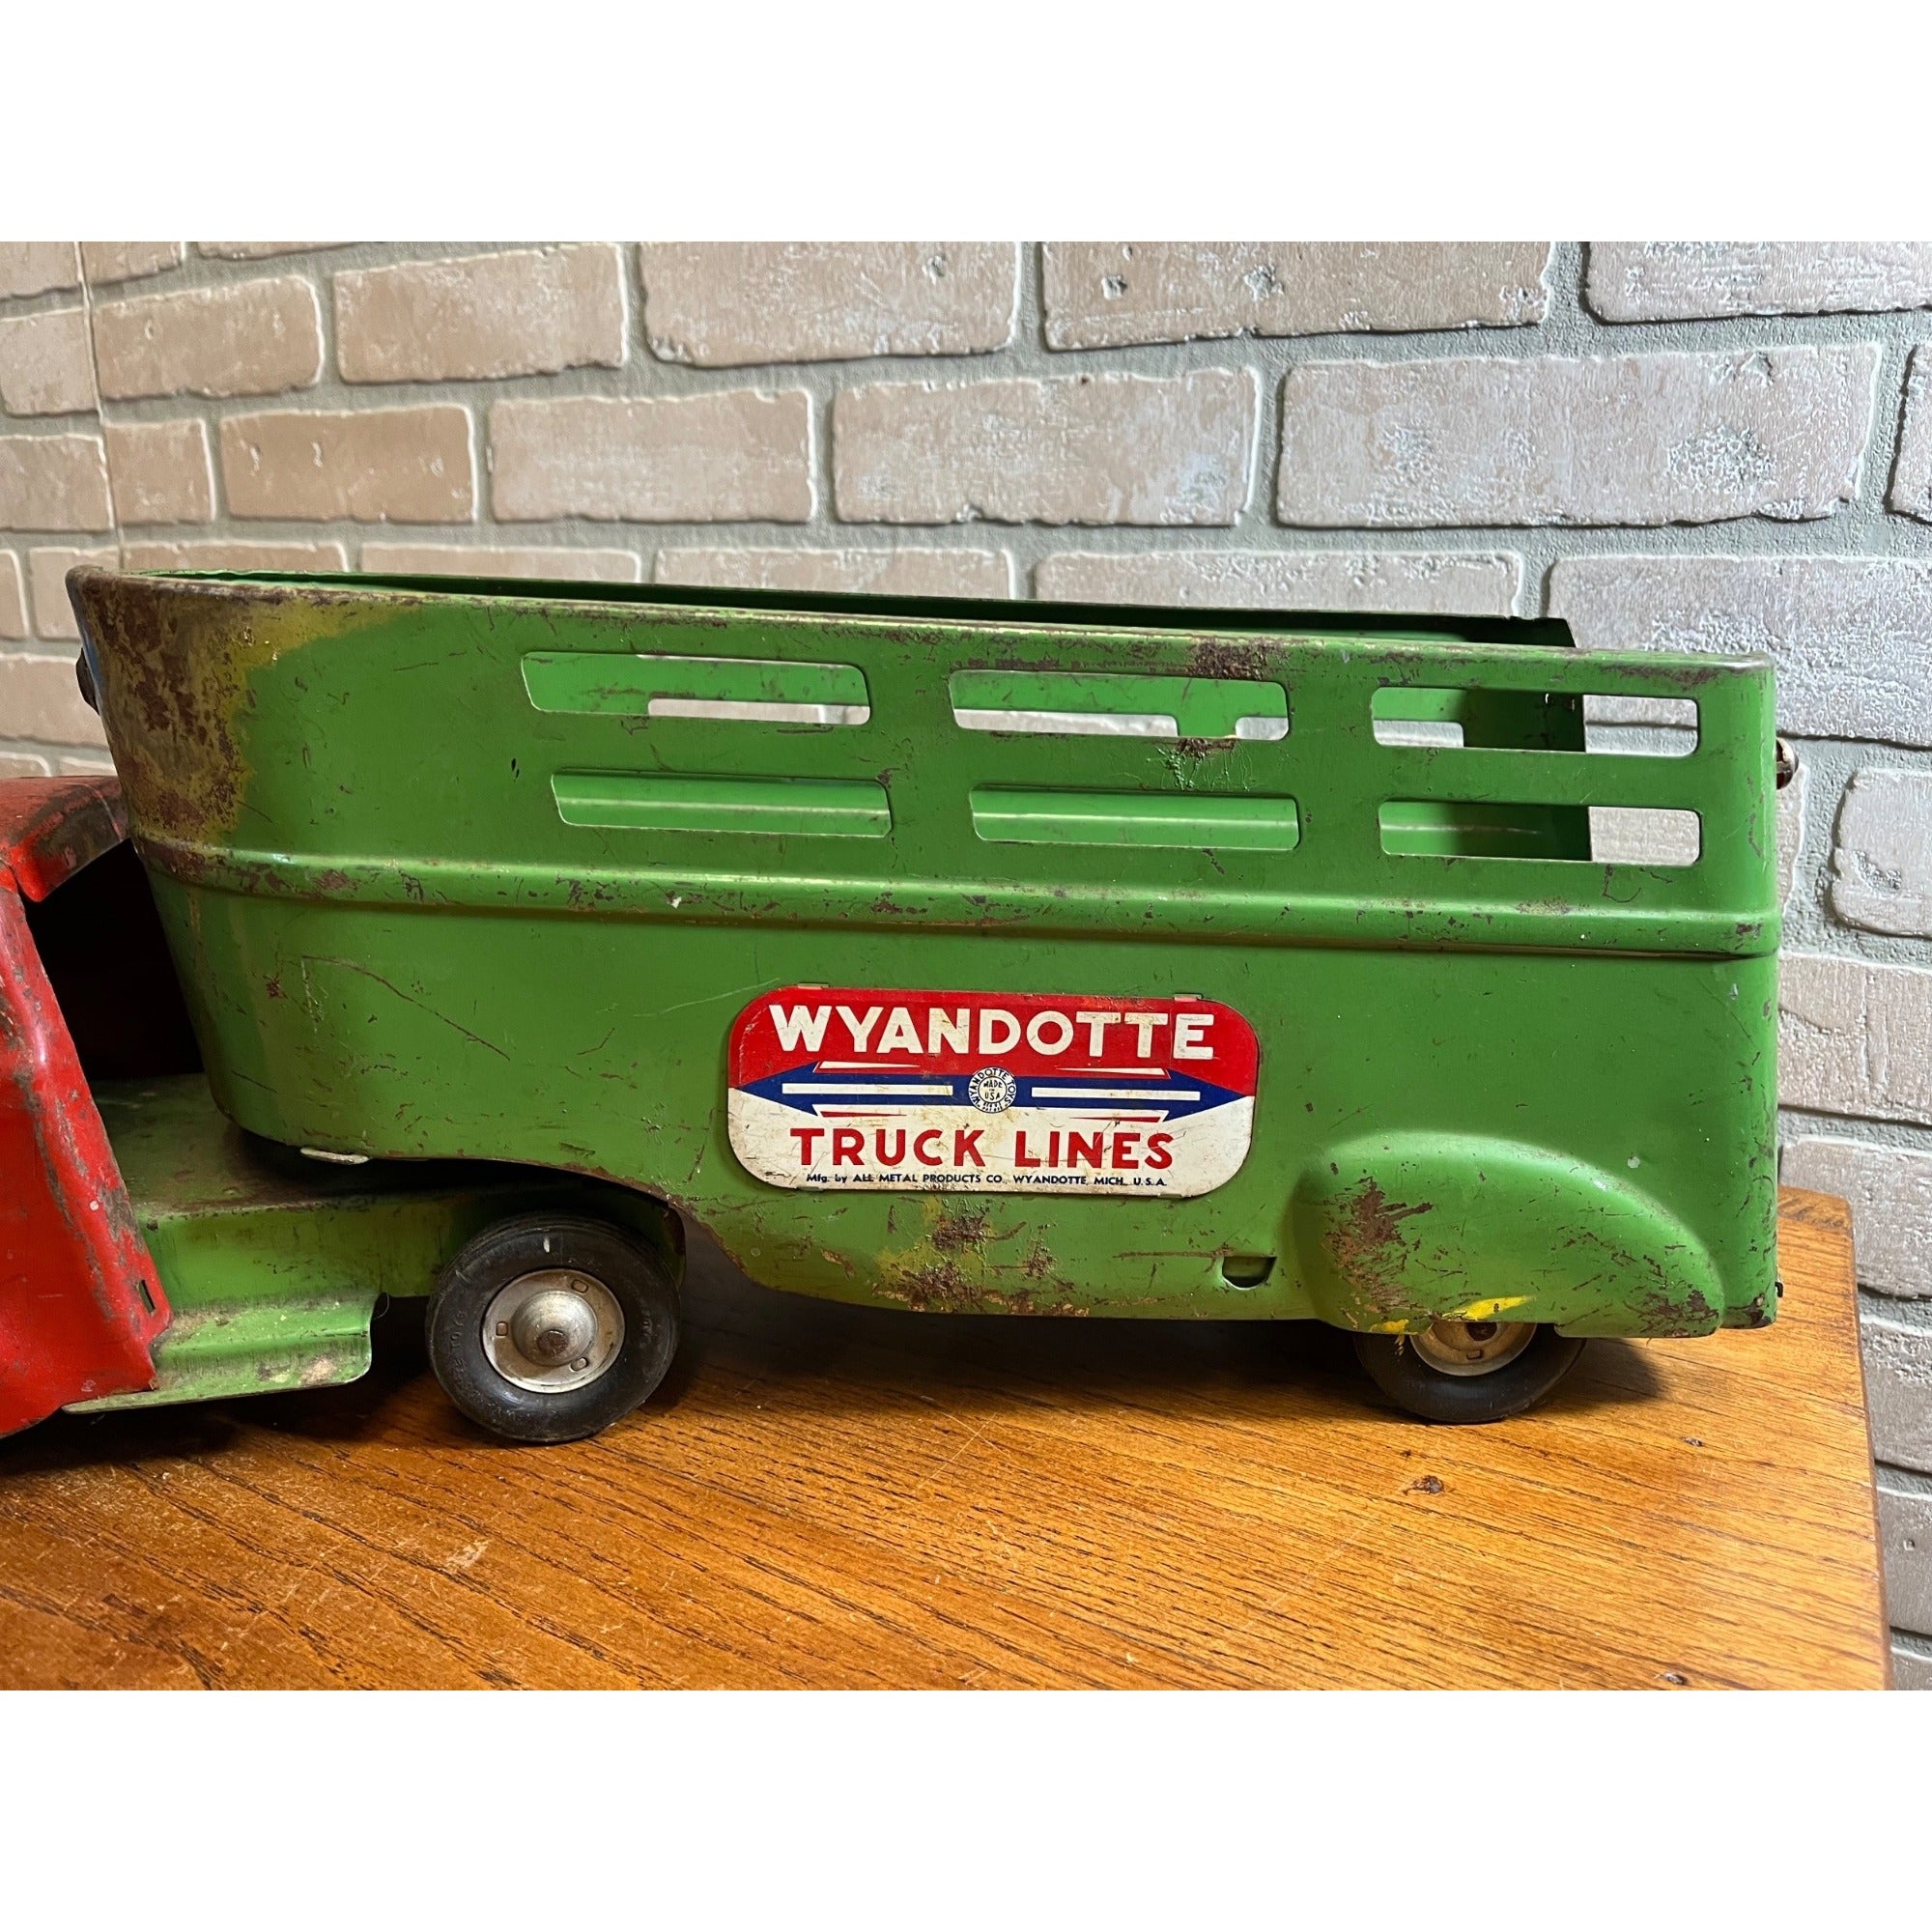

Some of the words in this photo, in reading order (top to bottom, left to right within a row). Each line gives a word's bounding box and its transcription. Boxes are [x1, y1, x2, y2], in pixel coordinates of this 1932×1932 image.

[768, 1005, 1214, 1060] WYANDOTTE
[969, 1067, 1009, 1105] WYANDOTTE
[1004, 1079, 1016, 1104] TOYS
[983, 1079, 1003, 1089] MADE
[789, 1127, 986, 1167] TRUCK
[1014, 1130, 1173, 1170] LINES
[806, 1173, 830, 1183] Mfg.
[834, 1173, 848, 1183] by
[852, 1174, 874, 1182] ALL
[878, 1174, 919, 1182] METAL
[923, 1174, 981, 1183] PRODUCTS
[1012, 1175, 1089, 1186] WYANDOTTE,
